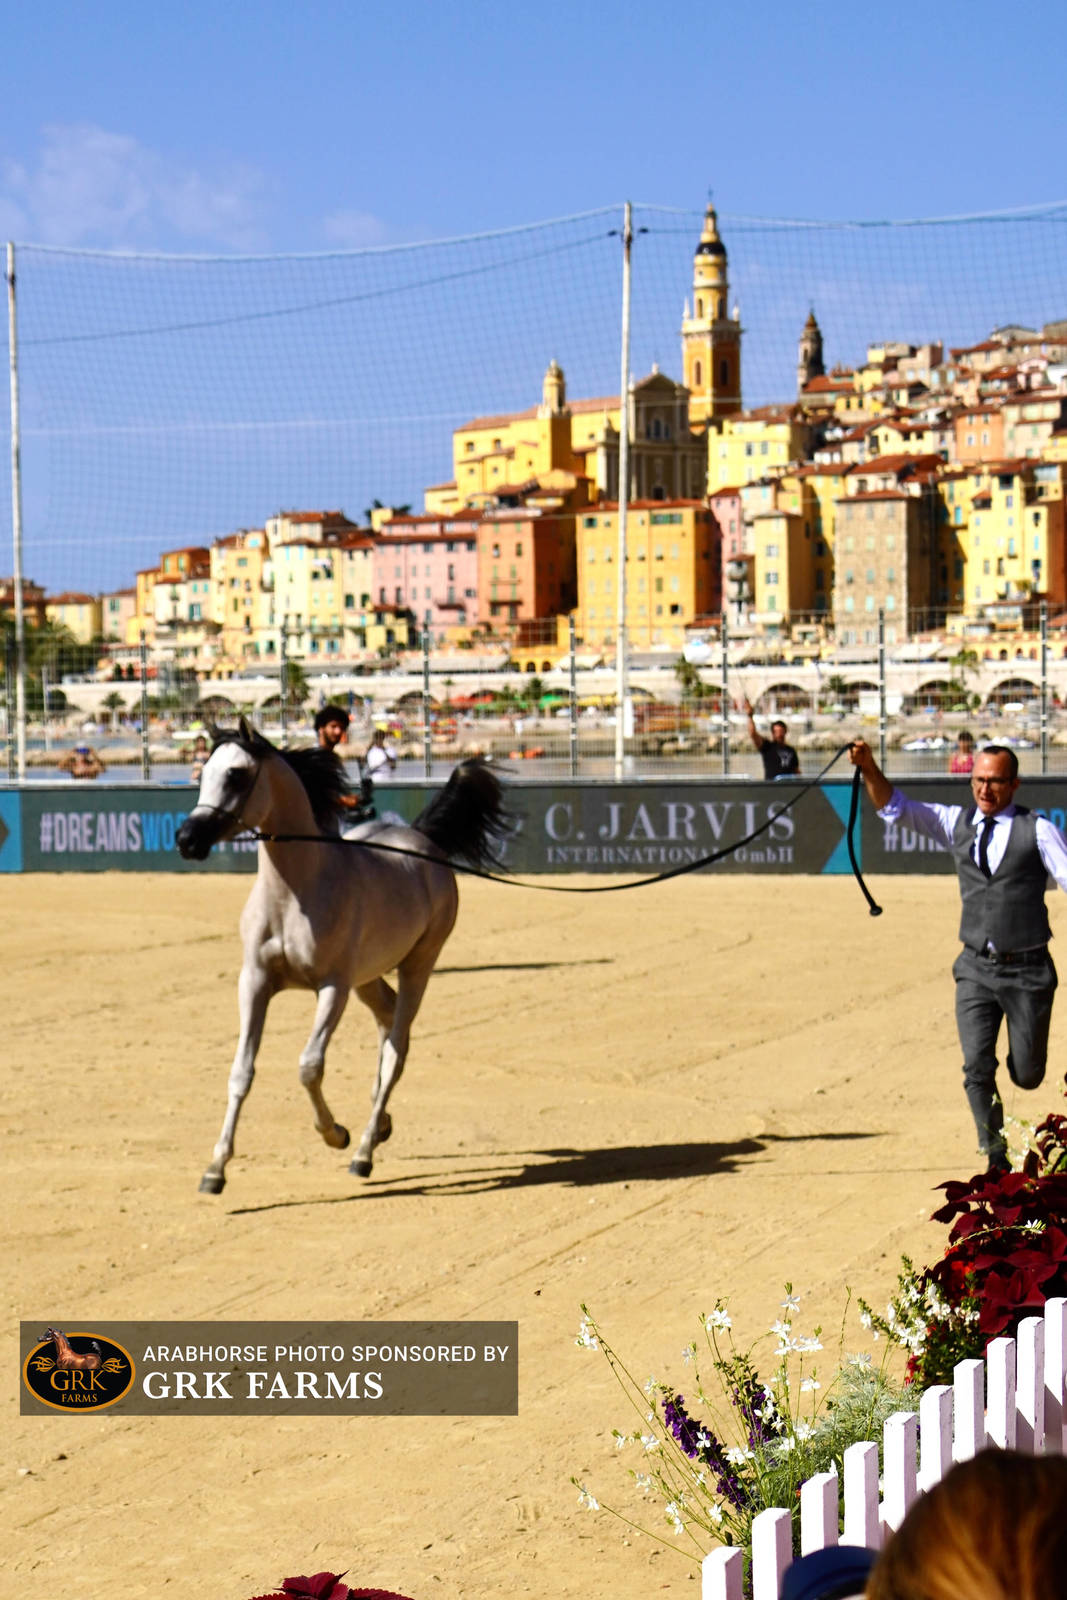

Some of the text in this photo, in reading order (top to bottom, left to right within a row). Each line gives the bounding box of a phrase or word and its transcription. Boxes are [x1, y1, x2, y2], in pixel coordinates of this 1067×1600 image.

[544, 801, 795, 840] C. JARVIS
[734, 846, 793, 863] GmbH
